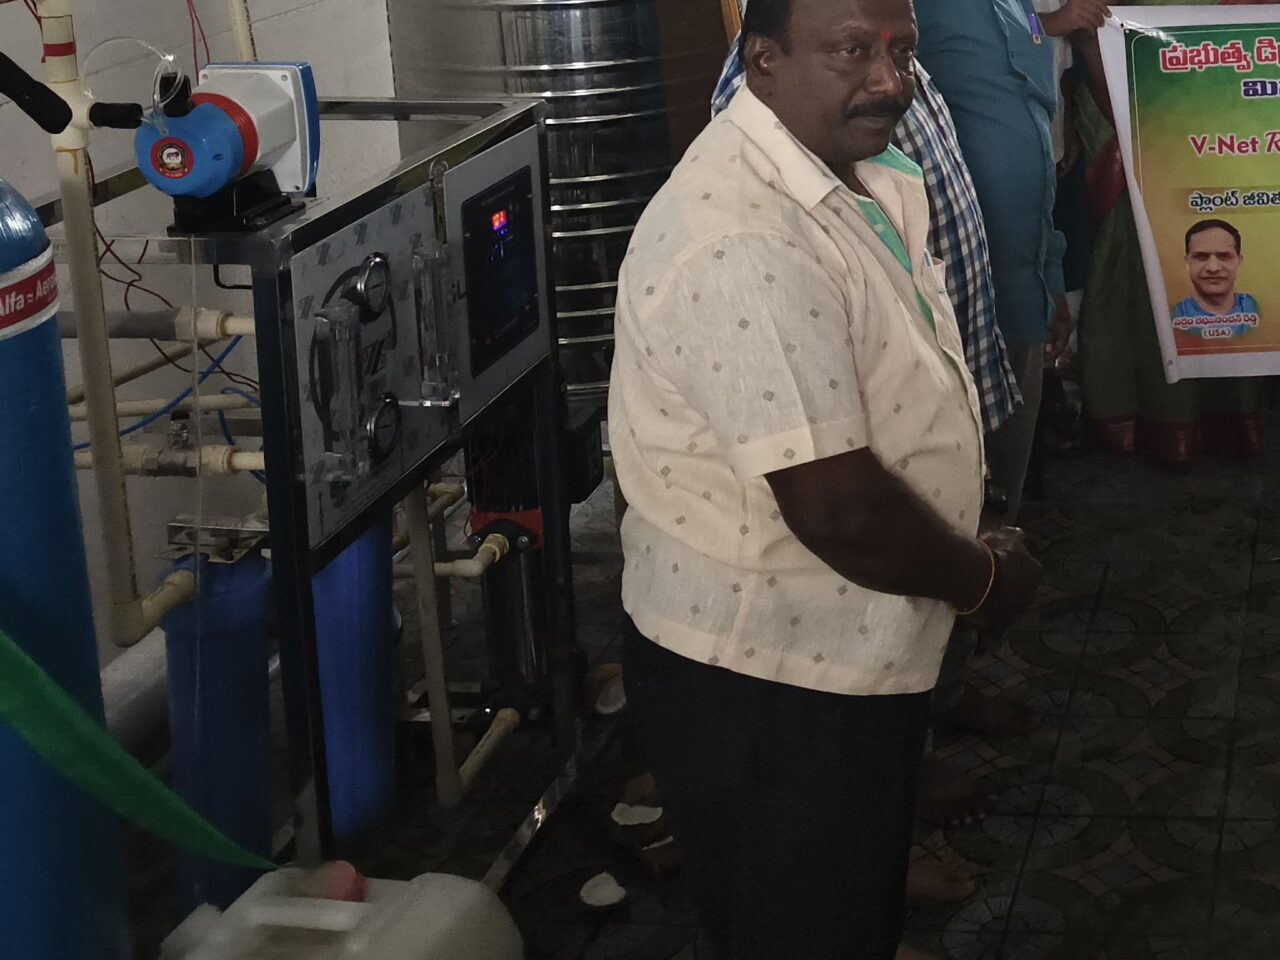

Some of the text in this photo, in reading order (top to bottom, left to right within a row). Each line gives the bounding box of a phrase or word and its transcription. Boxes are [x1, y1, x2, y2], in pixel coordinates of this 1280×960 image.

[1161, 42, 1252, 72] ప్రభుత్వ
[1190, 135, 1260, 156] V-Net
[1190, 191, 1239, 212] ప్లాంట్
[1203, 328, 1232, 338] (USA)
